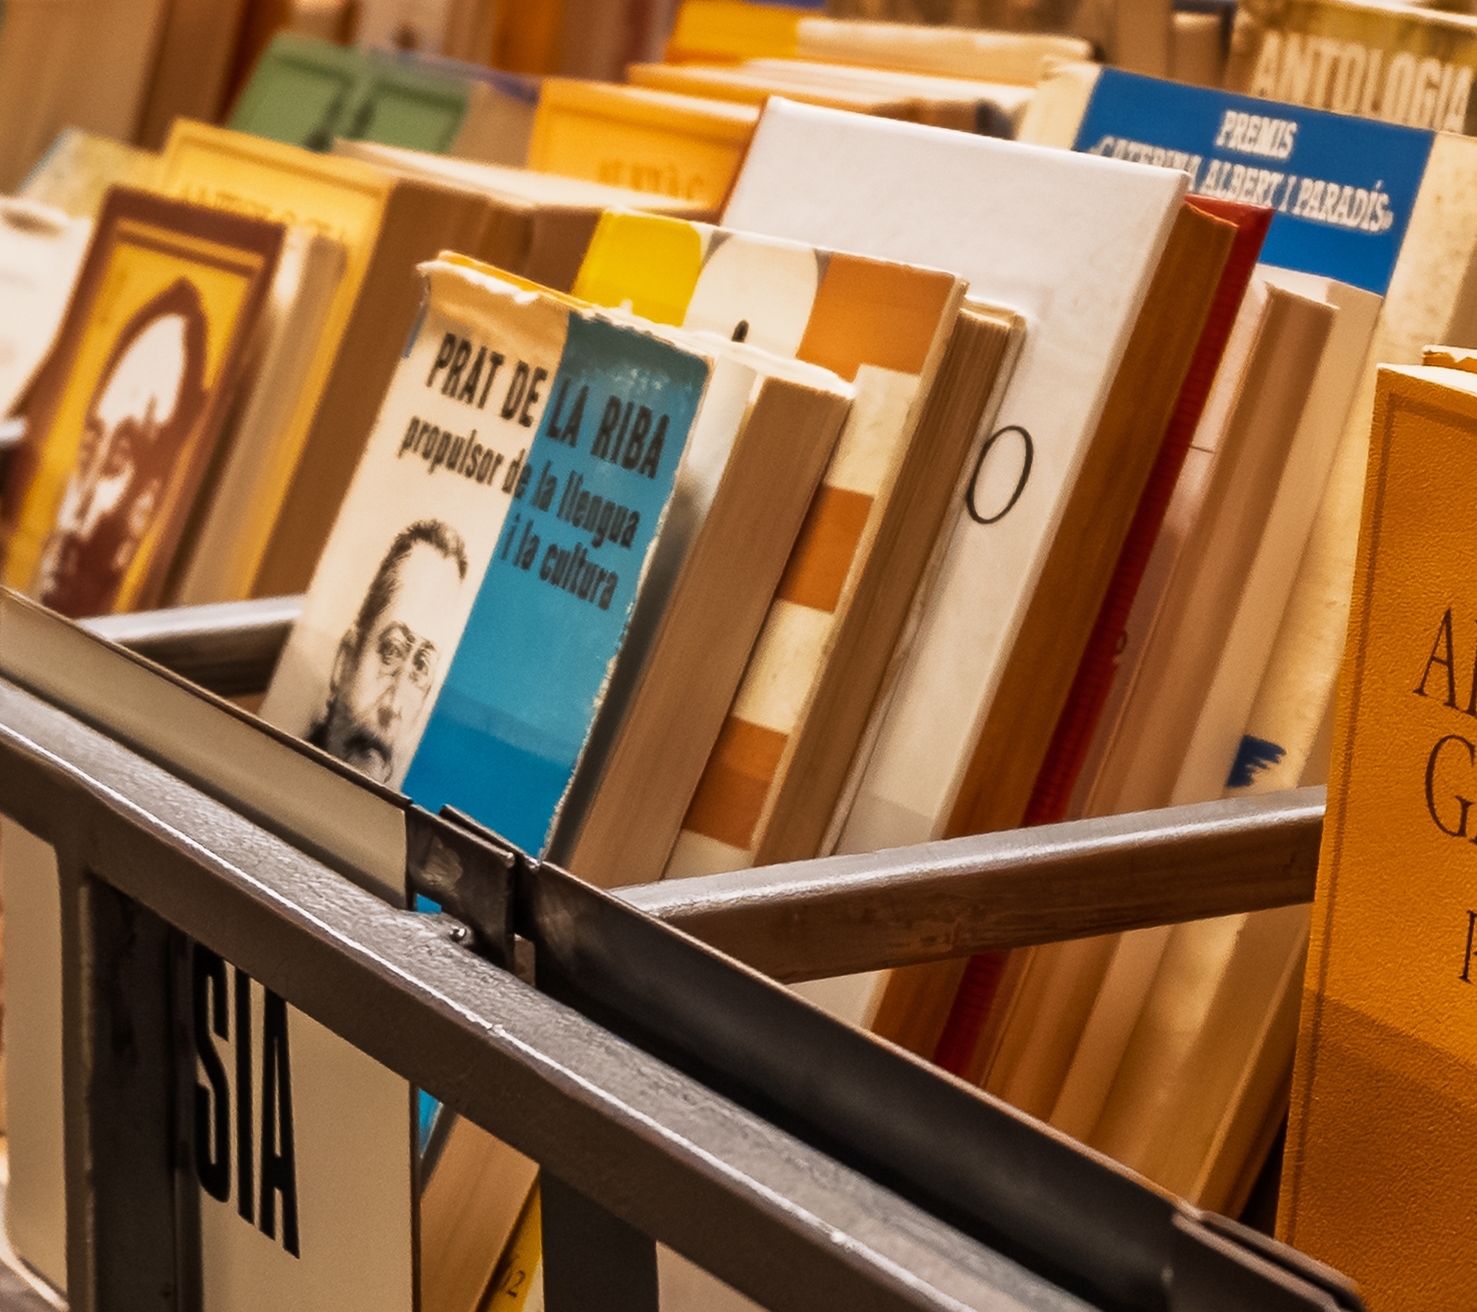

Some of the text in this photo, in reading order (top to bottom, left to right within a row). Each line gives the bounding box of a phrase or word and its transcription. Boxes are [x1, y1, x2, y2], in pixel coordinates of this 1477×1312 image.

[1250, 31, 1477, 134] ANTOLOGIA
[1202, 158, 1284, 208] ALBERT
[1215, 109, 1298, 161] PREMIS
[425, 332, 671, 480] PRAT DE LA RIBA
[397, 416, 641, 549] propulsor de la llengua
[500, 512, 619, 611] i la cultura
